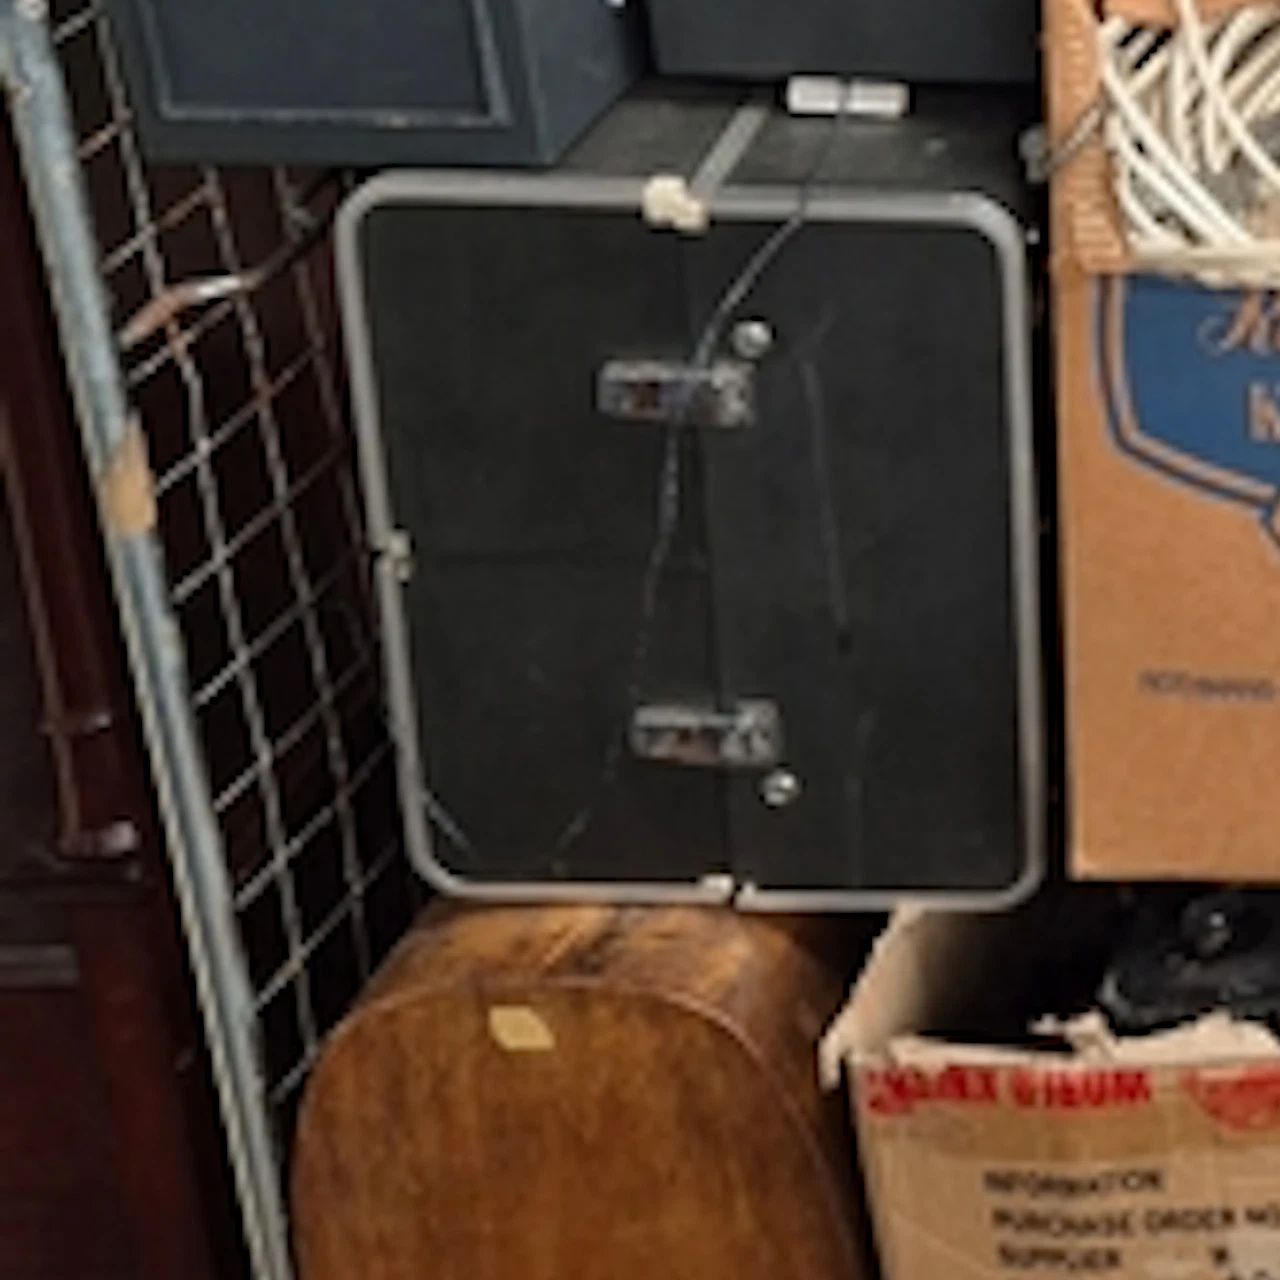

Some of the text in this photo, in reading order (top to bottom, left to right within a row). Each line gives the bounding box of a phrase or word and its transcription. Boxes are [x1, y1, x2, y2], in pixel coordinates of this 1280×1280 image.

[983, 1170, 1162, 1198] INFORMATION
[992, 1206, 1135, 1237] PURCHASE
[1143, 1206, 1237, 1234] ORDER
